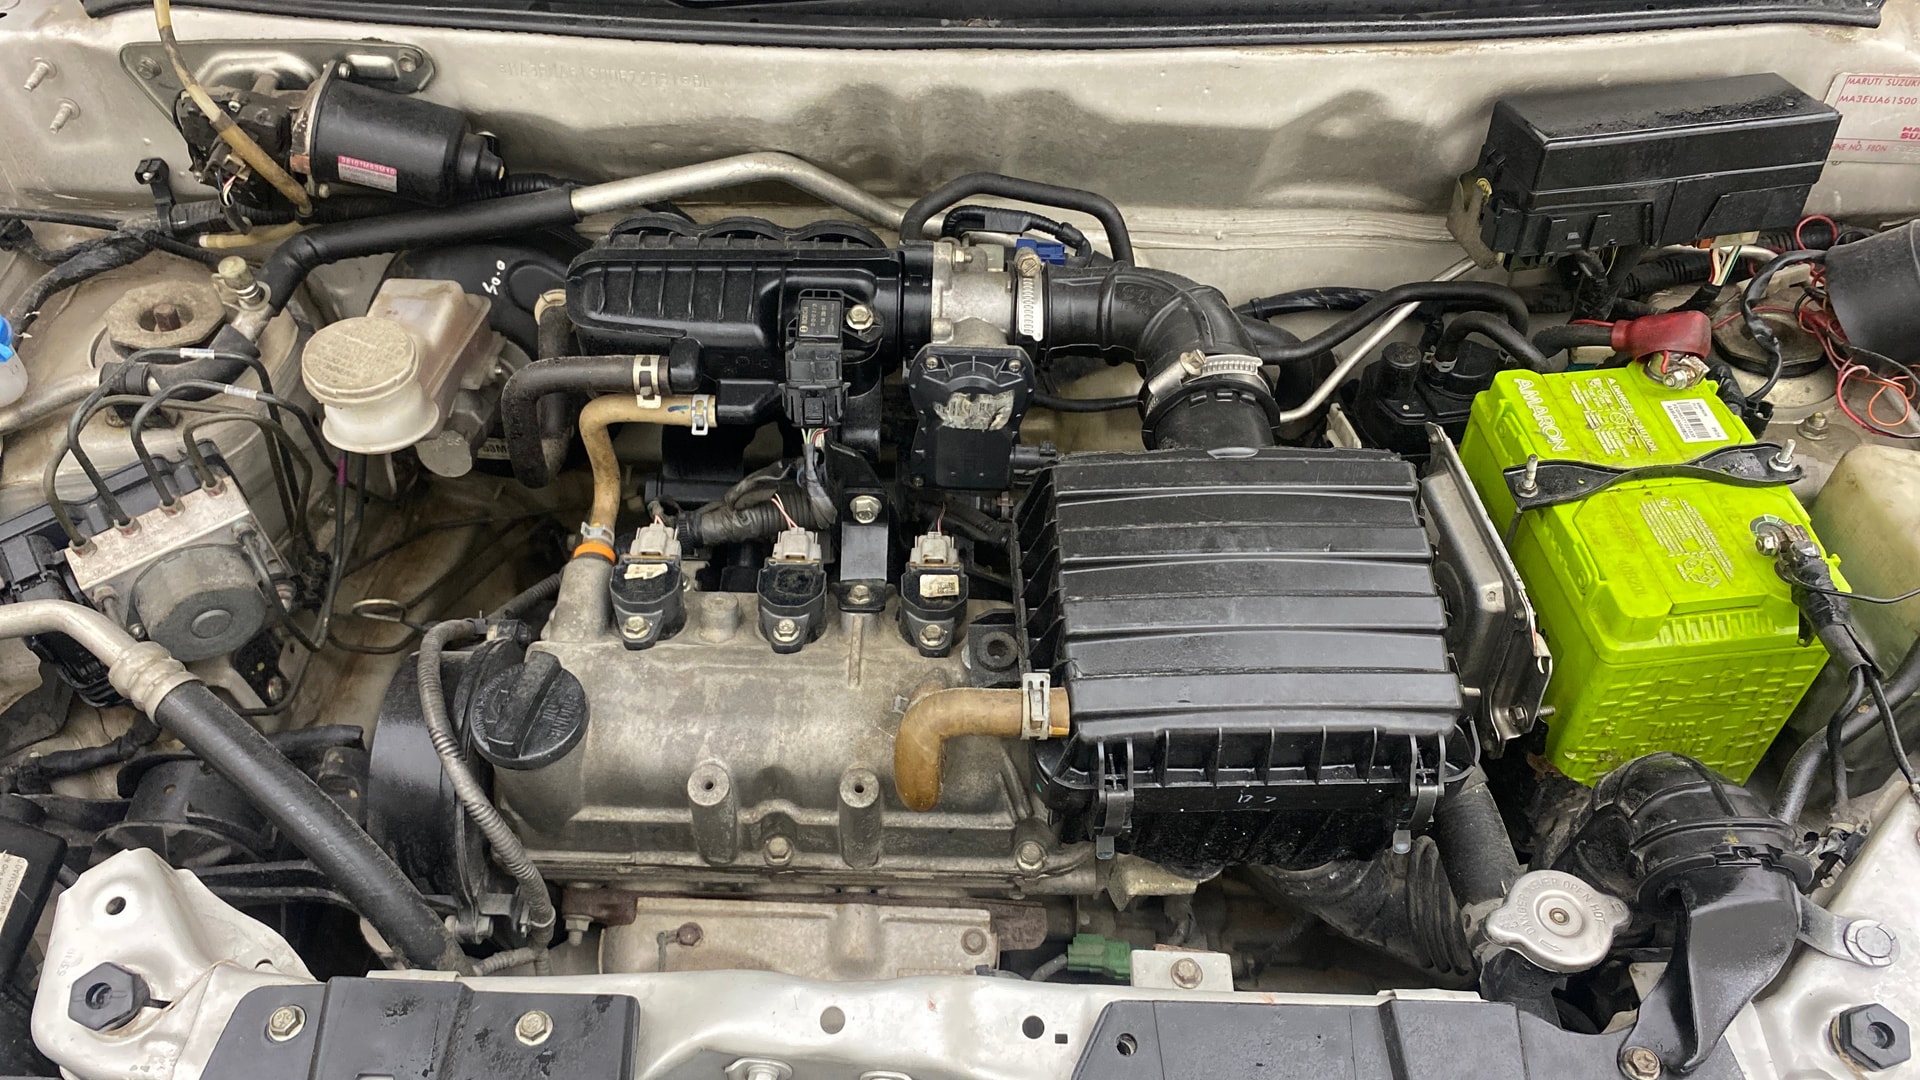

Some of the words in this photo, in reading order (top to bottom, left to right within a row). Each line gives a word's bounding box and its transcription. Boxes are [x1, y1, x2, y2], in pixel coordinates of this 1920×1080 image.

[1847, 78, 1882, 86] MARUTI
[1514, 378, 1570, 452] AMARON
[1517, 892, 1537, 936] DANGER
[1562, 880, 1594, 903] OPEN
[1590, 902, 1606, 924] HOT
